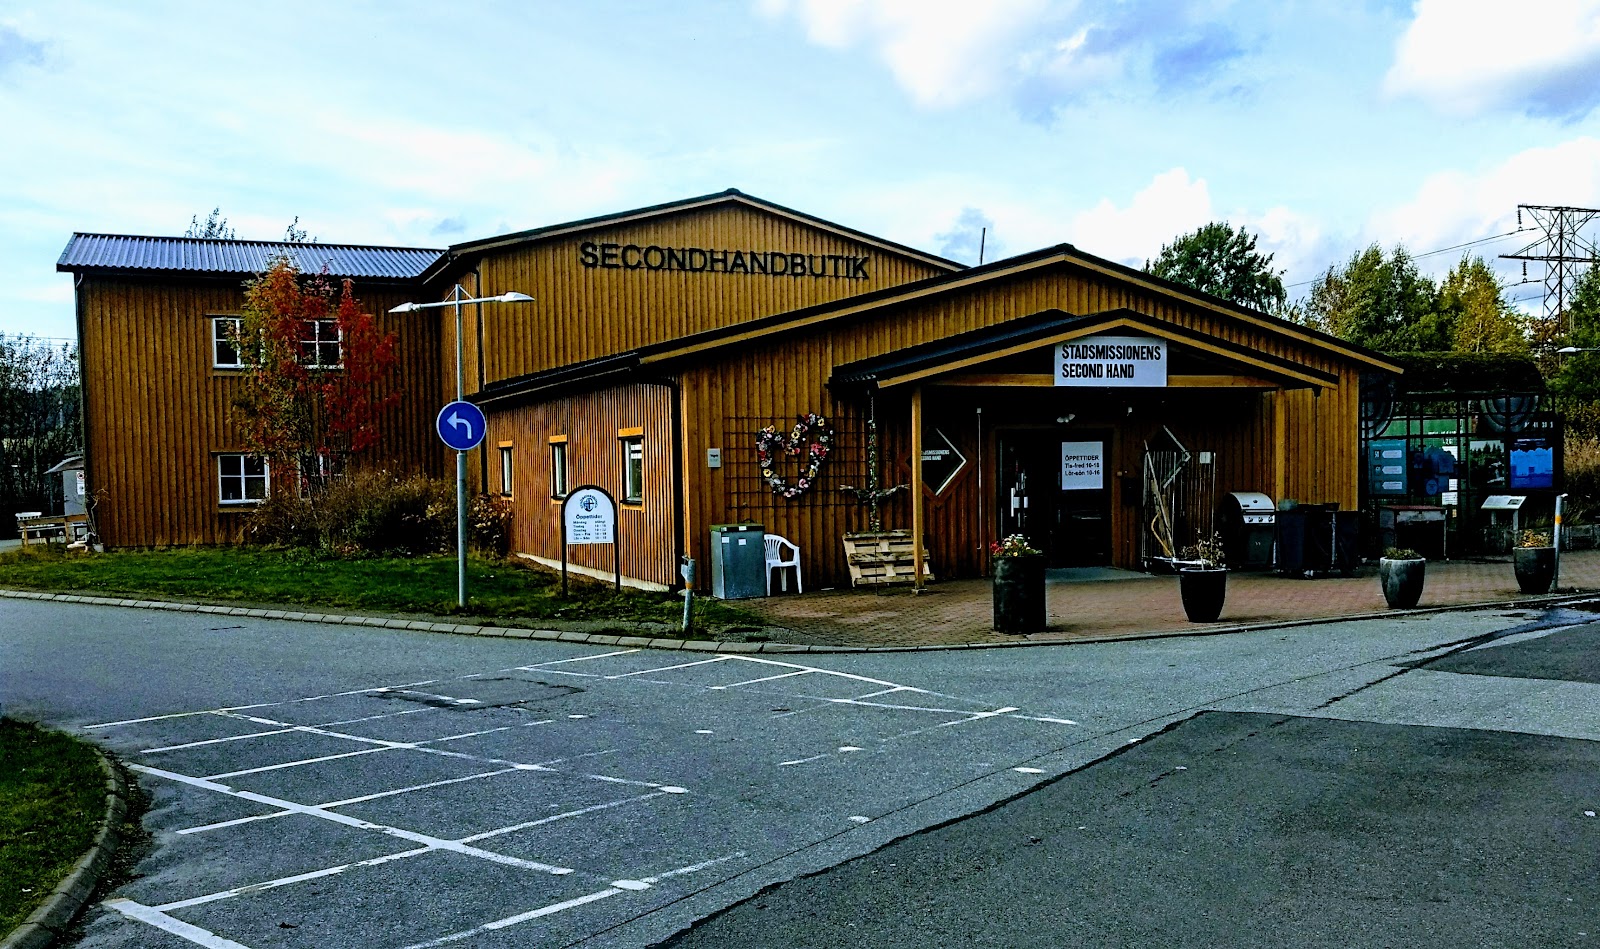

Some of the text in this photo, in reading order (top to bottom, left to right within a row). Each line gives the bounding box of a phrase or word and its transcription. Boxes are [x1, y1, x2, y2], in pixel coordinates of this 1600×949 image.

[579, 241, 869, 279] SECONDHANDBUTIK
[1061, 344, 1161, 360] STADSMISSIONENS
[1061, 363, 1135, 378] SECOND HAND
